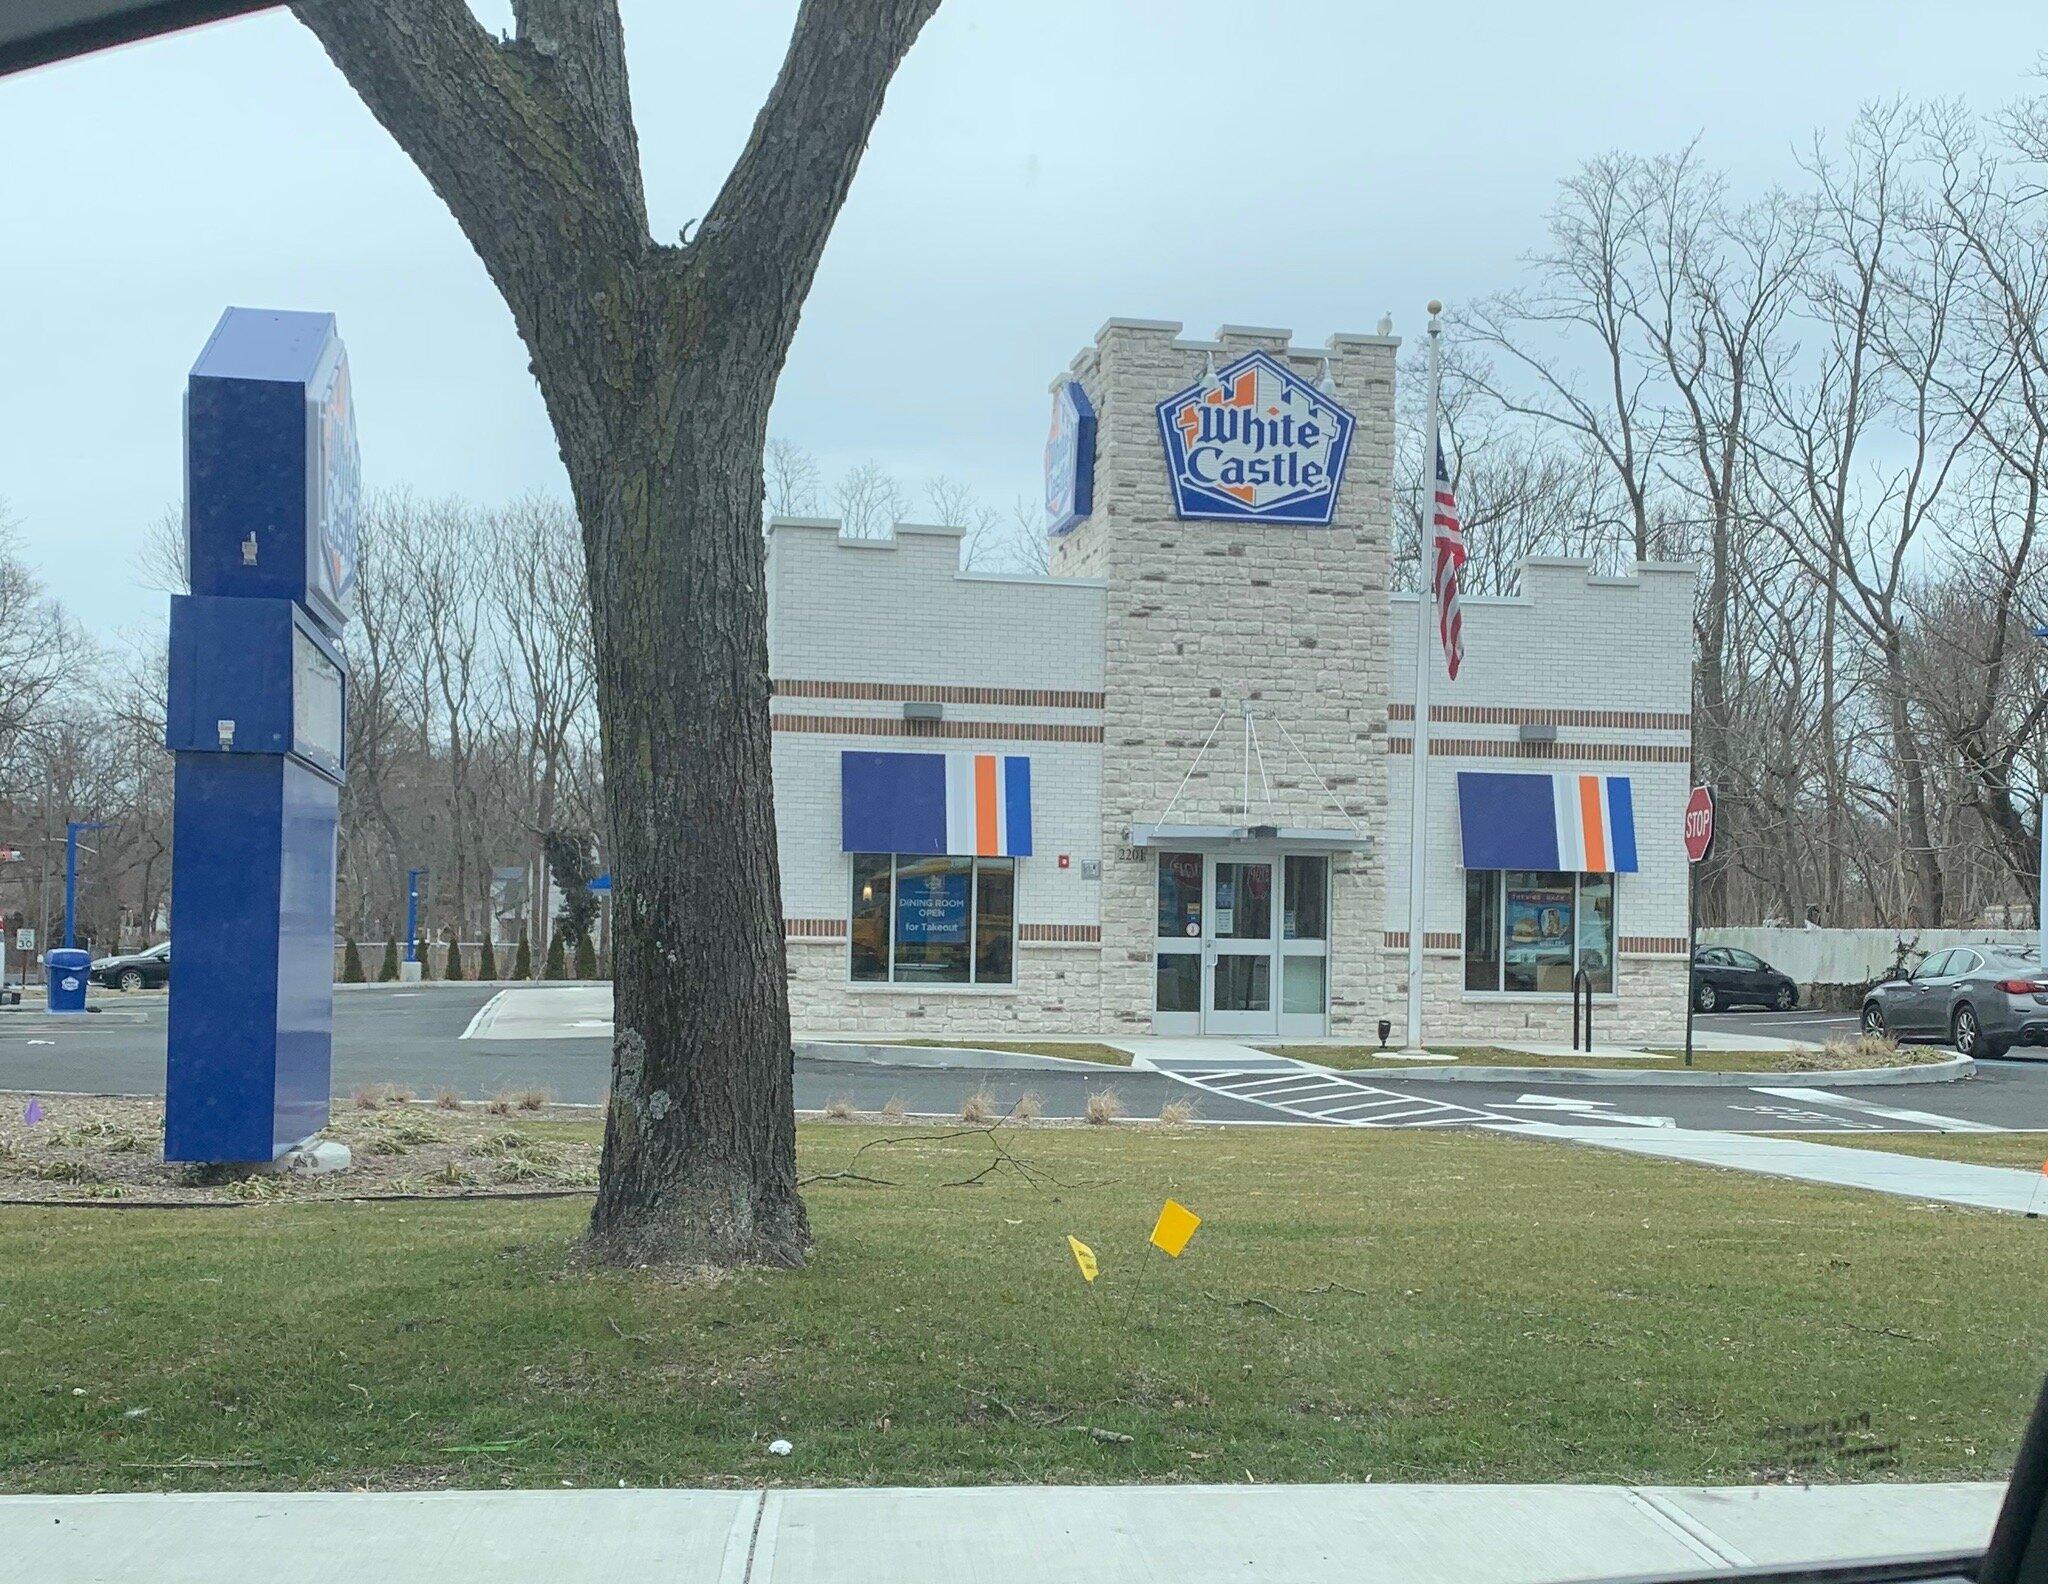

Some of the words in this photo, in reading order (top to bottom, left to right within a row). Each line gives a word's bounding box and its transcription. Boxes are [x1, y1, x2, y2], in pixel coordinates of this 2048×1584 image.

[1197, 404, 1320, 453] White
[1187, 446, 1323, 488] Castle
[1686, 809, 1710, 839] STOP
[900, 899, 933, 907] DINING
[935, 899, 964, 907] ROOM
[918, 909, 945, 917] OPEN
[905, 922, 919, 931] for
[921, 922, 959, 932] Takeout
[19, 939, 32, 948] 30
